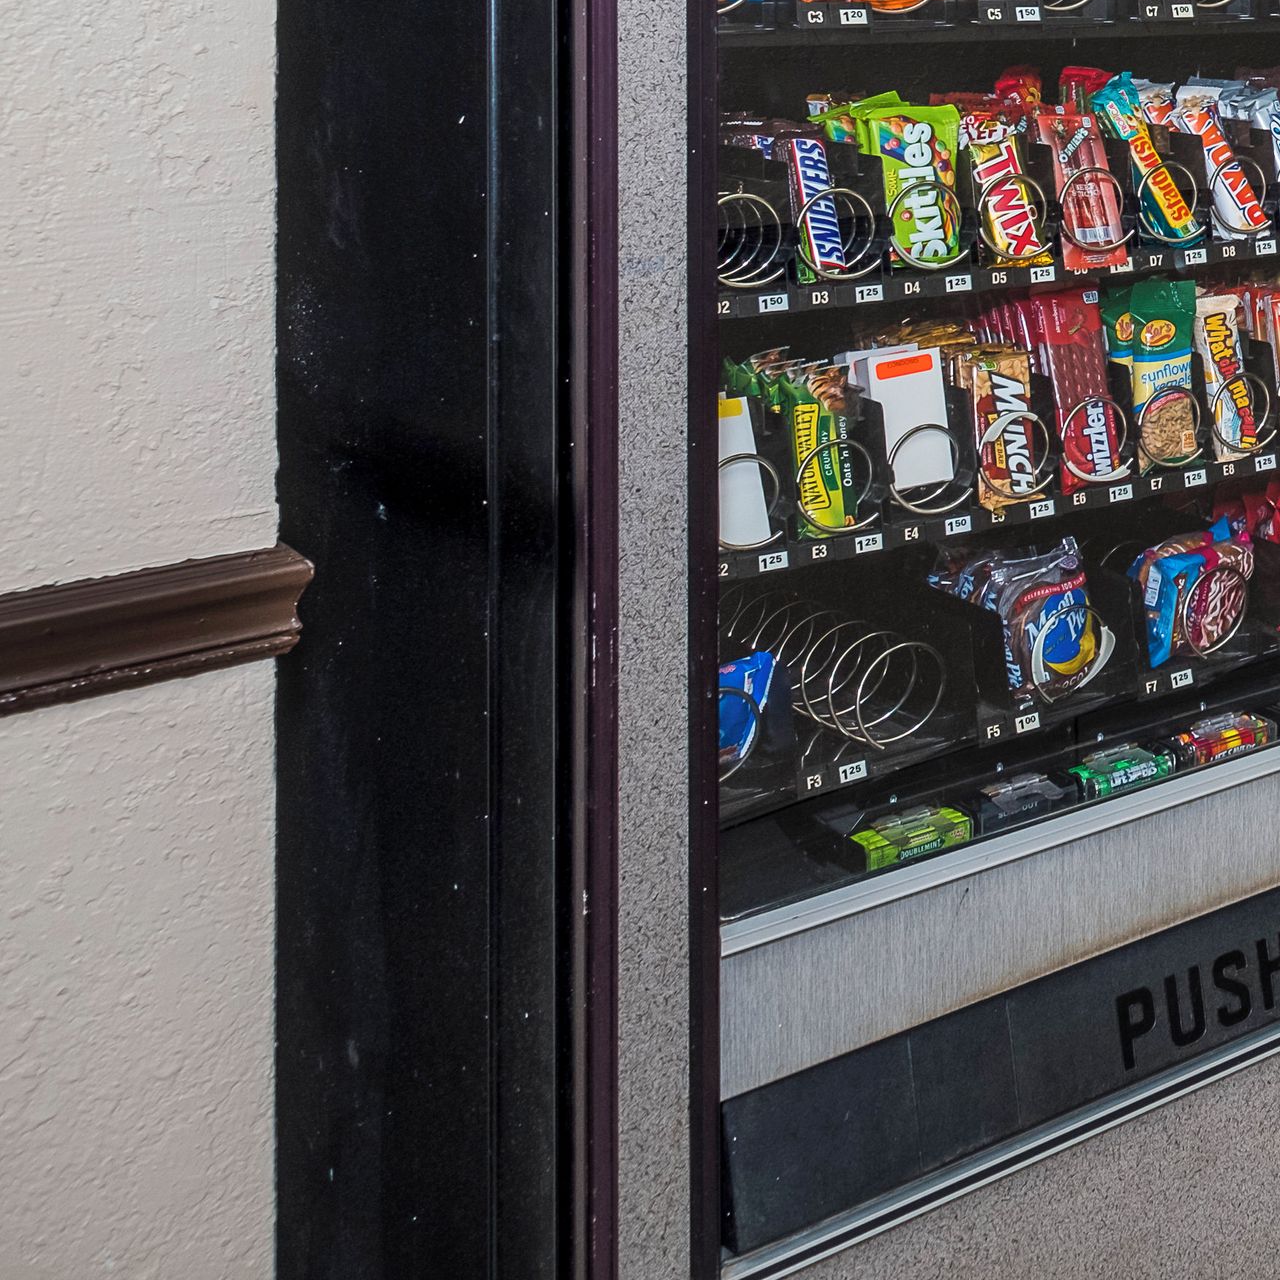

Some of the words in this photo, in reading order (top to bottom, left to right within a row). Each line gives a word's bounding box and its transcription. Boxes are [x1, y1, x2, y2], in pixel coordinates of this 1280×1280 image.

[986, 7, 1002, 21] C5
[1145, 5, 1159, 17] C7
[887, 167, 896, 197] SOUR
[795, 138, 846, 265] SNICKERS
[972, 141, 1043, 257] TWIX
[1222, 244, 1236, 258] D8
[1149, 254, 1163, 267] D7
[991, 271, 1008, 285] D5
[904, 281, 921, 295] D4
[812, 291, 830, 305] D3
[1140, 362, 1192, 386] sunflow
[794, 403, 819, 454] VALLEY
[842, 459, 853, 487] Oats
[1222, 463, 1235, 476] E8
[798, 454, 828, 507] NATURE
[1150, 477, 1163, 490] E7
[1073, 492, 1087, 505] E6
[904, 526, 920, 541] E4
[811, 544, 828, 559] E3
[1025, 590, 1075, 650] Moon
[1065, 606, 1087, 642] Pie
[1145, 680, 1158, 694] F7
[986, 724, 1001, 739] F5
[806, 773, 823, 790] F3
[900, 836, 943, 860] DOUBLEMINT
